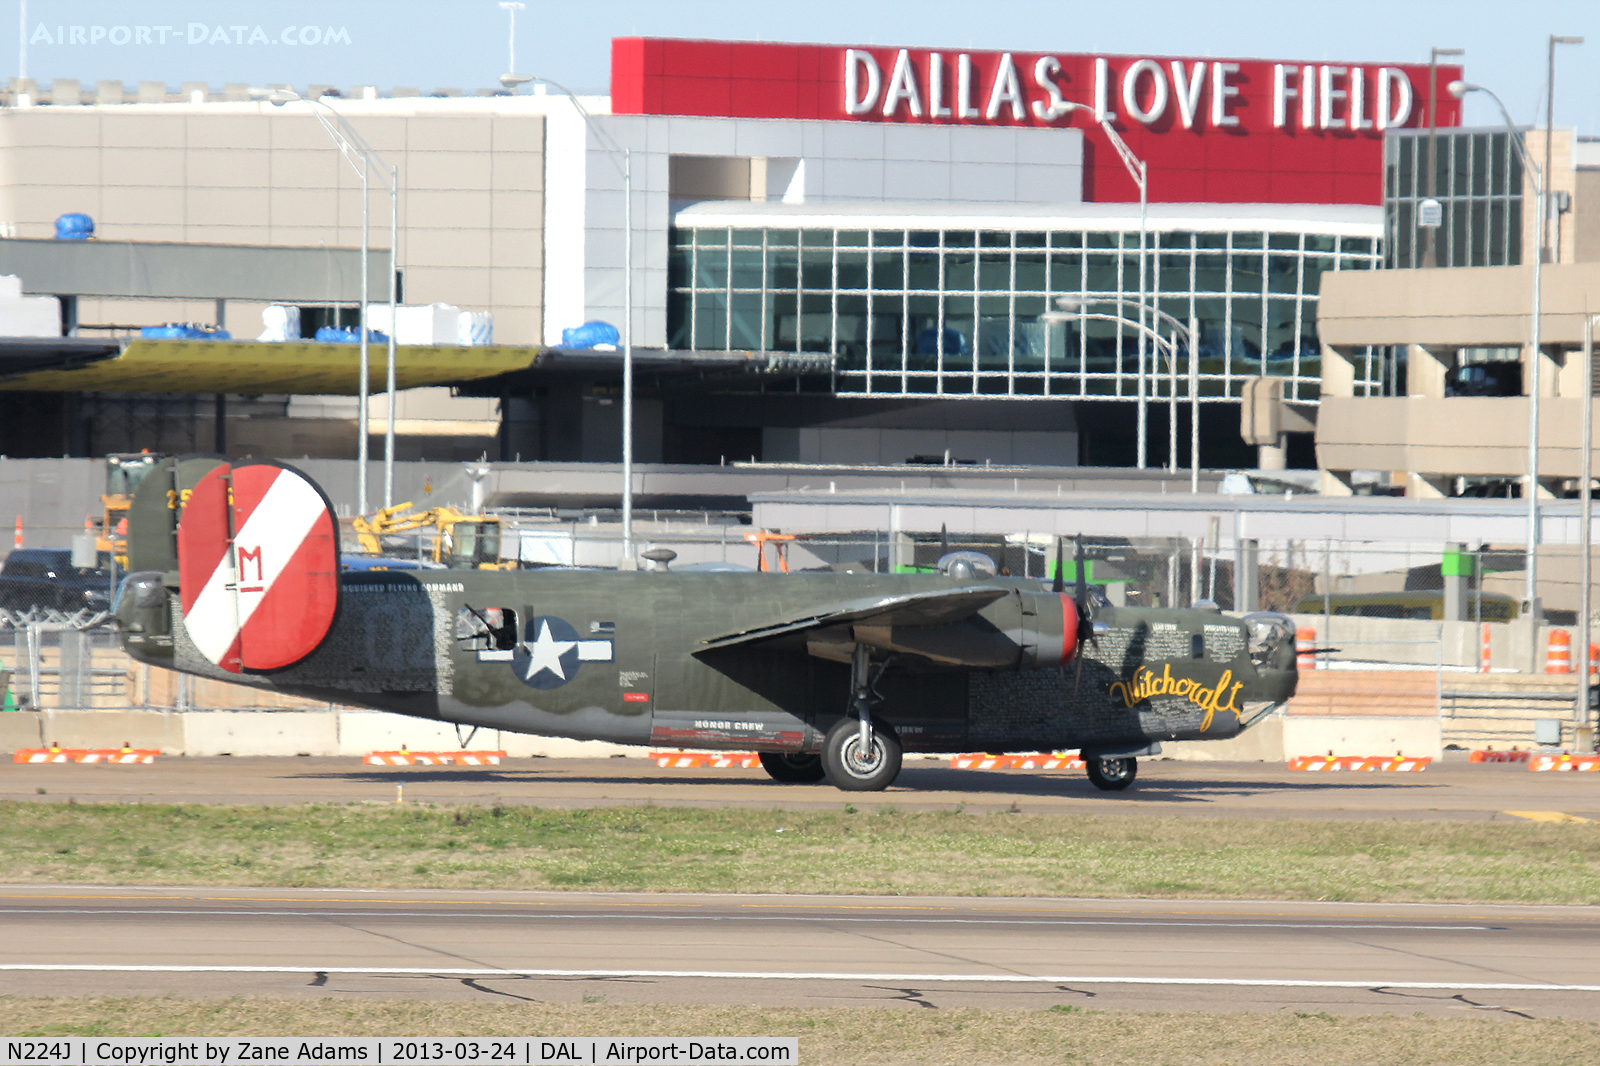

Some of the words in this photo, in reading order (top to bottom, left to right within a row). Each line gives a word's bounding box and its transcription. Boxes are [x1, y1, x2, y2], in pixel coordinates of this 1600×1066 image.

[844, 48, 1060, 122] DALLAS
[1095, 57, 1240, 129] LOVE
[1272, 63, 1414, 131] FIELD
[238, 545, 263, 582] M
[421, 582, 465, 593] COMMAND
[1109, 663, 1244, 733] Witchcraft
[695, 719, 732, 730] HONOR
[734, 721, 764, 731] CREW
